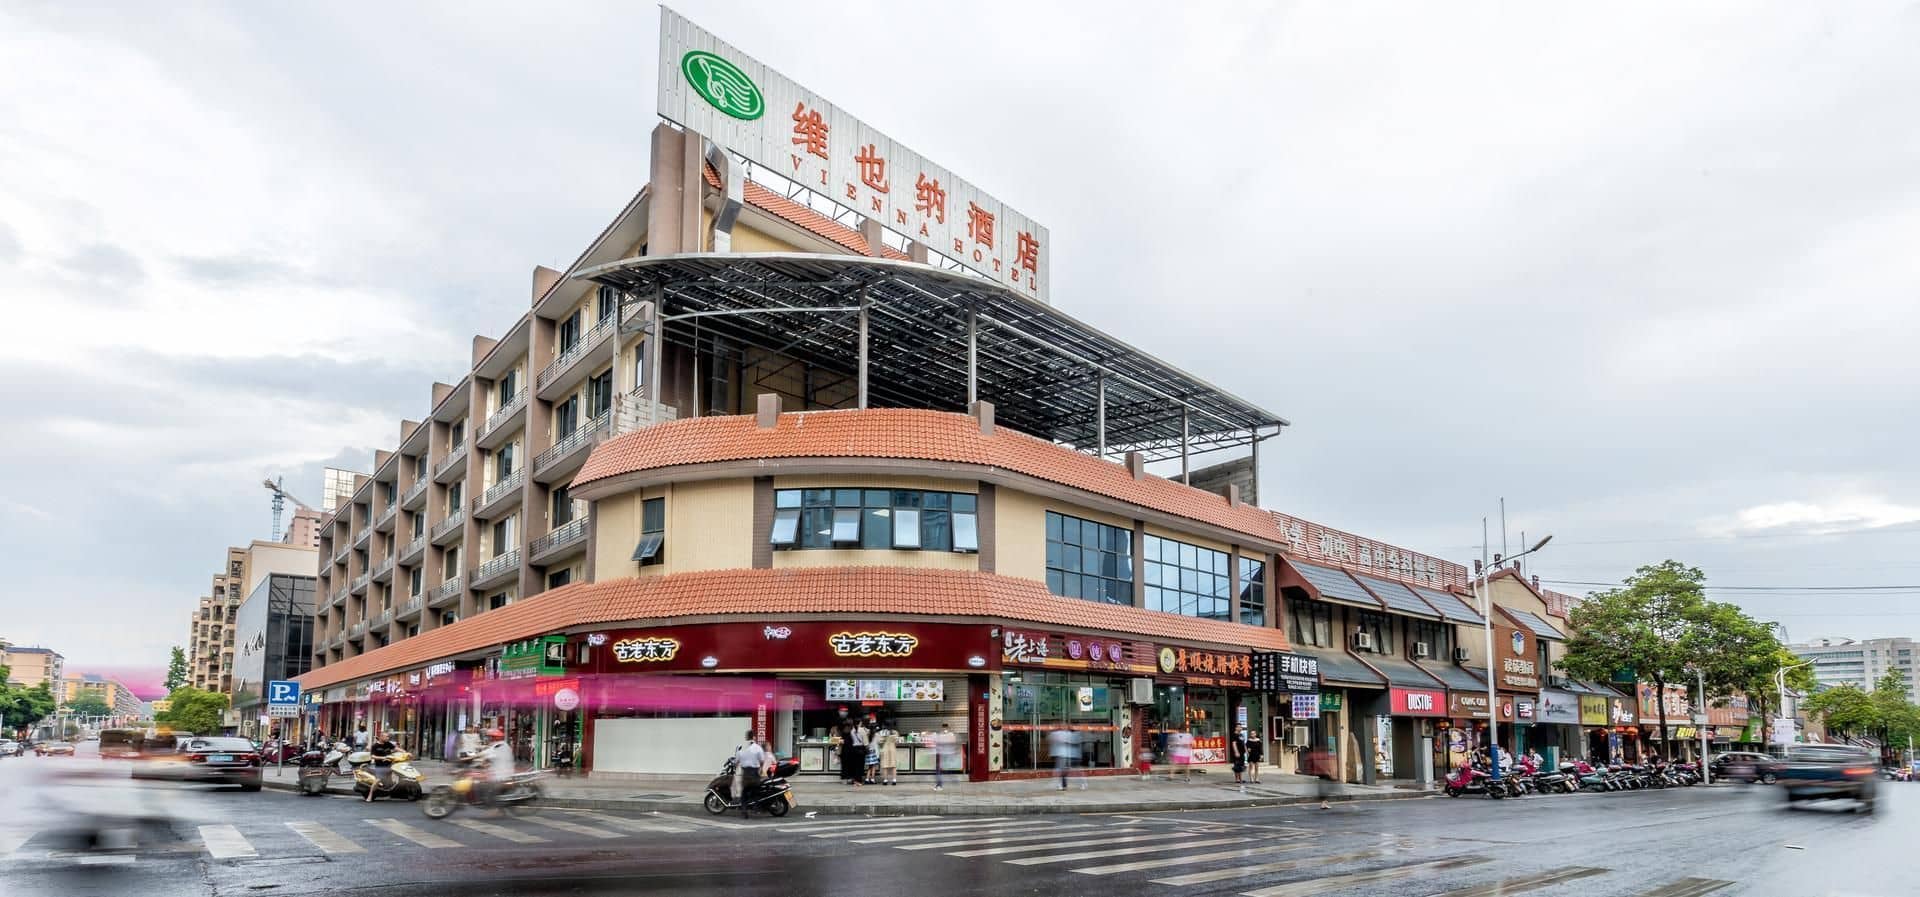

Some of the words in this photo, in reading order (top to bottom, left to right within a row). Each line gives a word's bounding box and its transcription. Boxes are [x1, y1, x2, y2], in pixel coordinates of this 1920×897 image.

[792, 102, 1040, 274] 维也纳酒店
[791, 153, 929, 238] VIENNA
[954, 237, 1038, 292] HOTEL
[613, 638, 679, 661] 古老东方
[829, 632, 918, 656] 古老东方
[1004, 633, 1049, 663] 老上海
[1281, 656, 1317, 675] 手机快修
[271, 684, 291, 701] P
